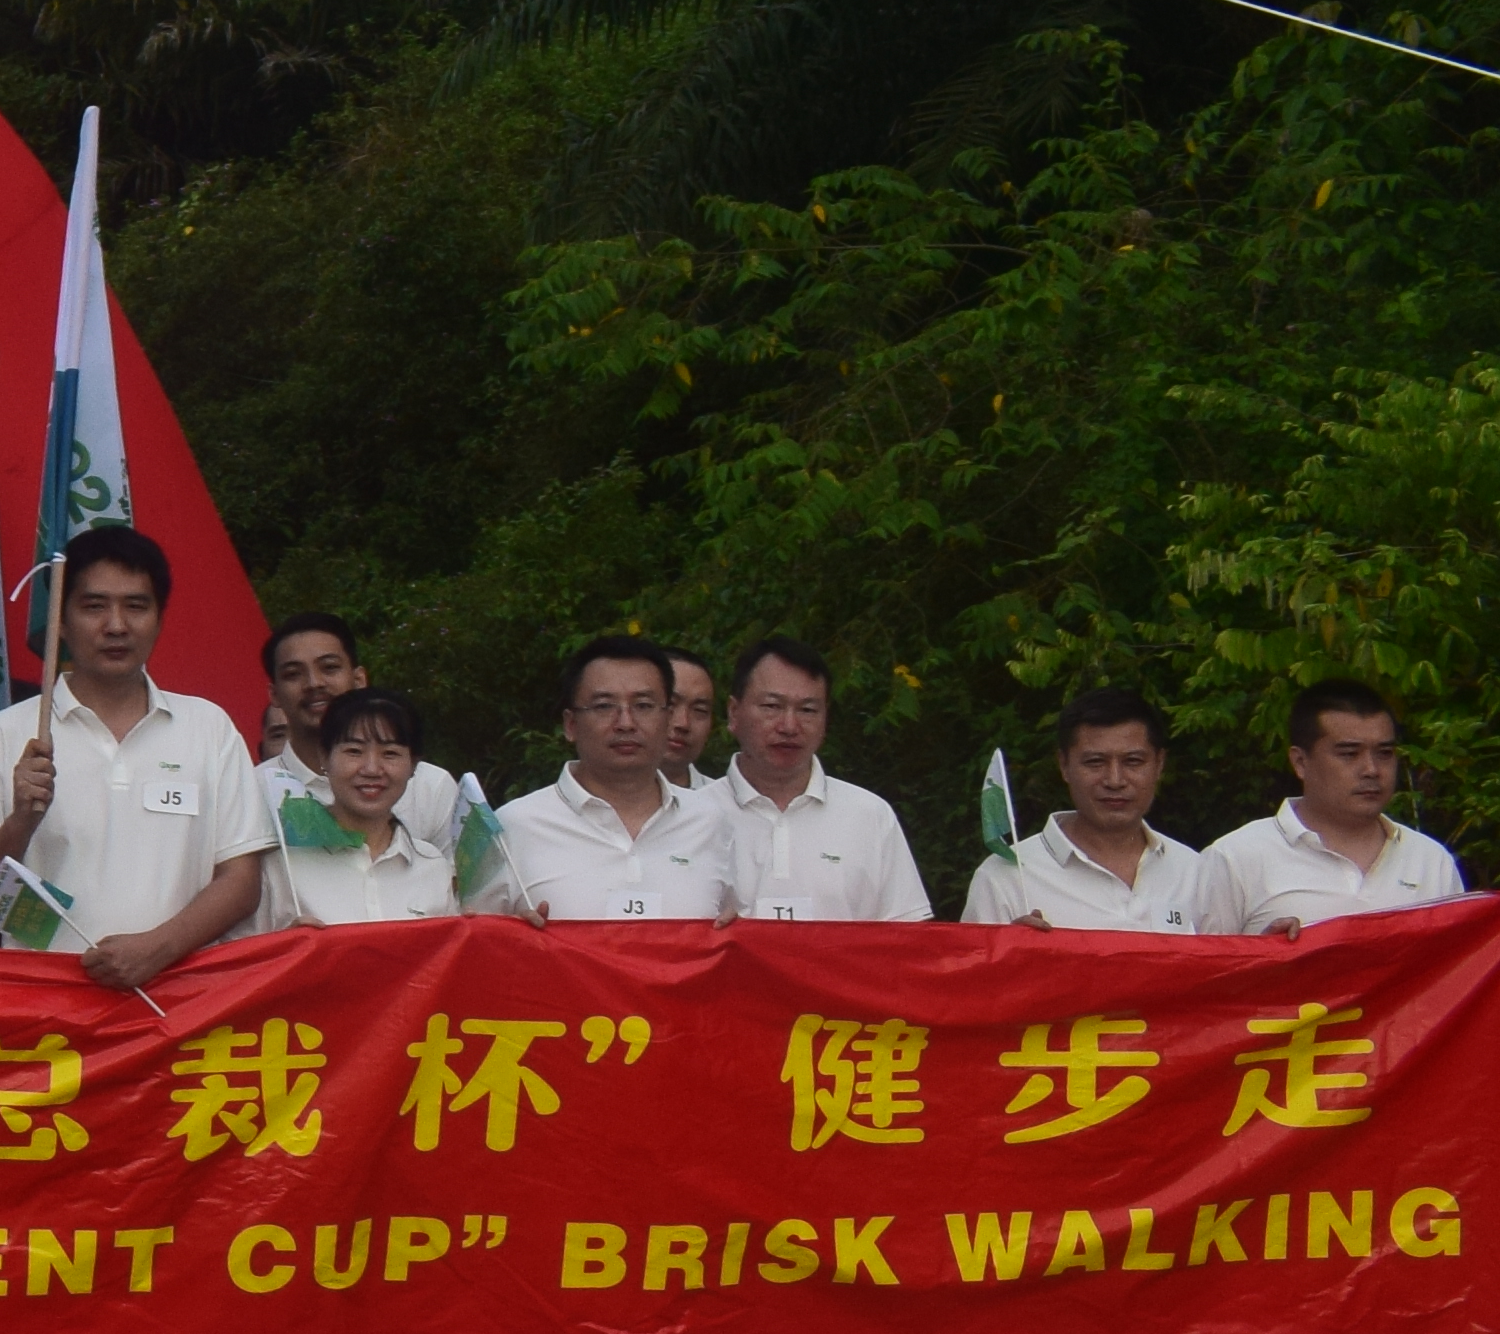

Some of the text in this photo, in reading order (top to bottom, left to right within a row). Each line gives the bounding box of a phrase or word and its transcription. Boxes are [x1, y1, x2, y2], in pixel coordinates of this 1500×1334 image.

[160, 790, 183, 806] J5
[623, 899, 645, 915] J3
[1166, 909, 1182, 926] J8
[560, 1214, 901, 1291] BRISK
[944, 1186, 1464, 1283] WALKING
